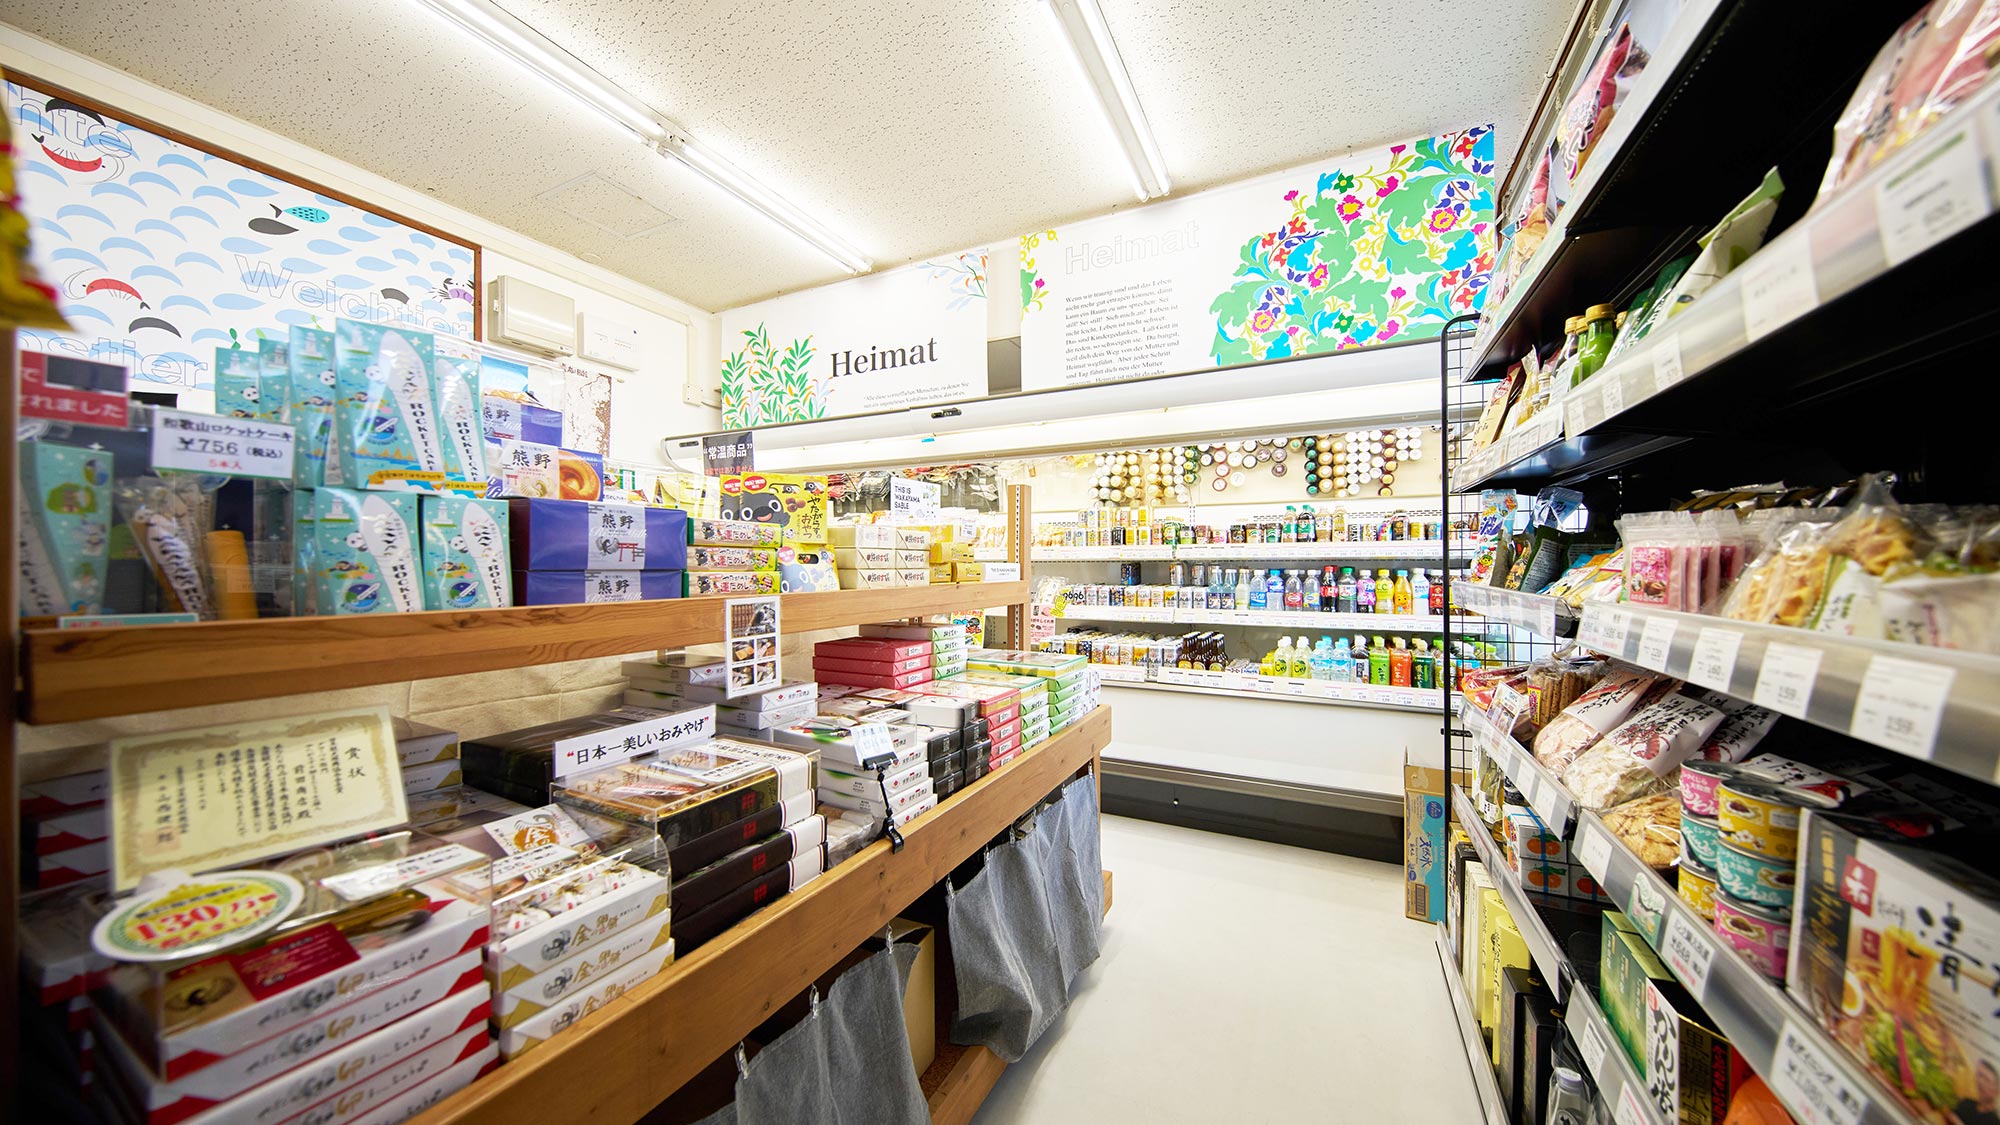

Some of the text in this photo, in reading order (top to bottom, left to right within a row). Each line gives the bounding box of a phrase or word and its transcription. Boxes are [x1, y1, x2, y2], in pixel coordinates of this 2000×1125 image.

[1065, 220, 1200, 275] Heimat
[831, 336, 938, 378] Heimat
[161, 417, 293, 442] 和歌山ロケットケーキ
[511, 449, 552, 469] 熊野
[601, 513, 635, 530] 熊野
[597, 579, 630, 595] 熊野
[1419, 836, 1433, 869] 天然水
